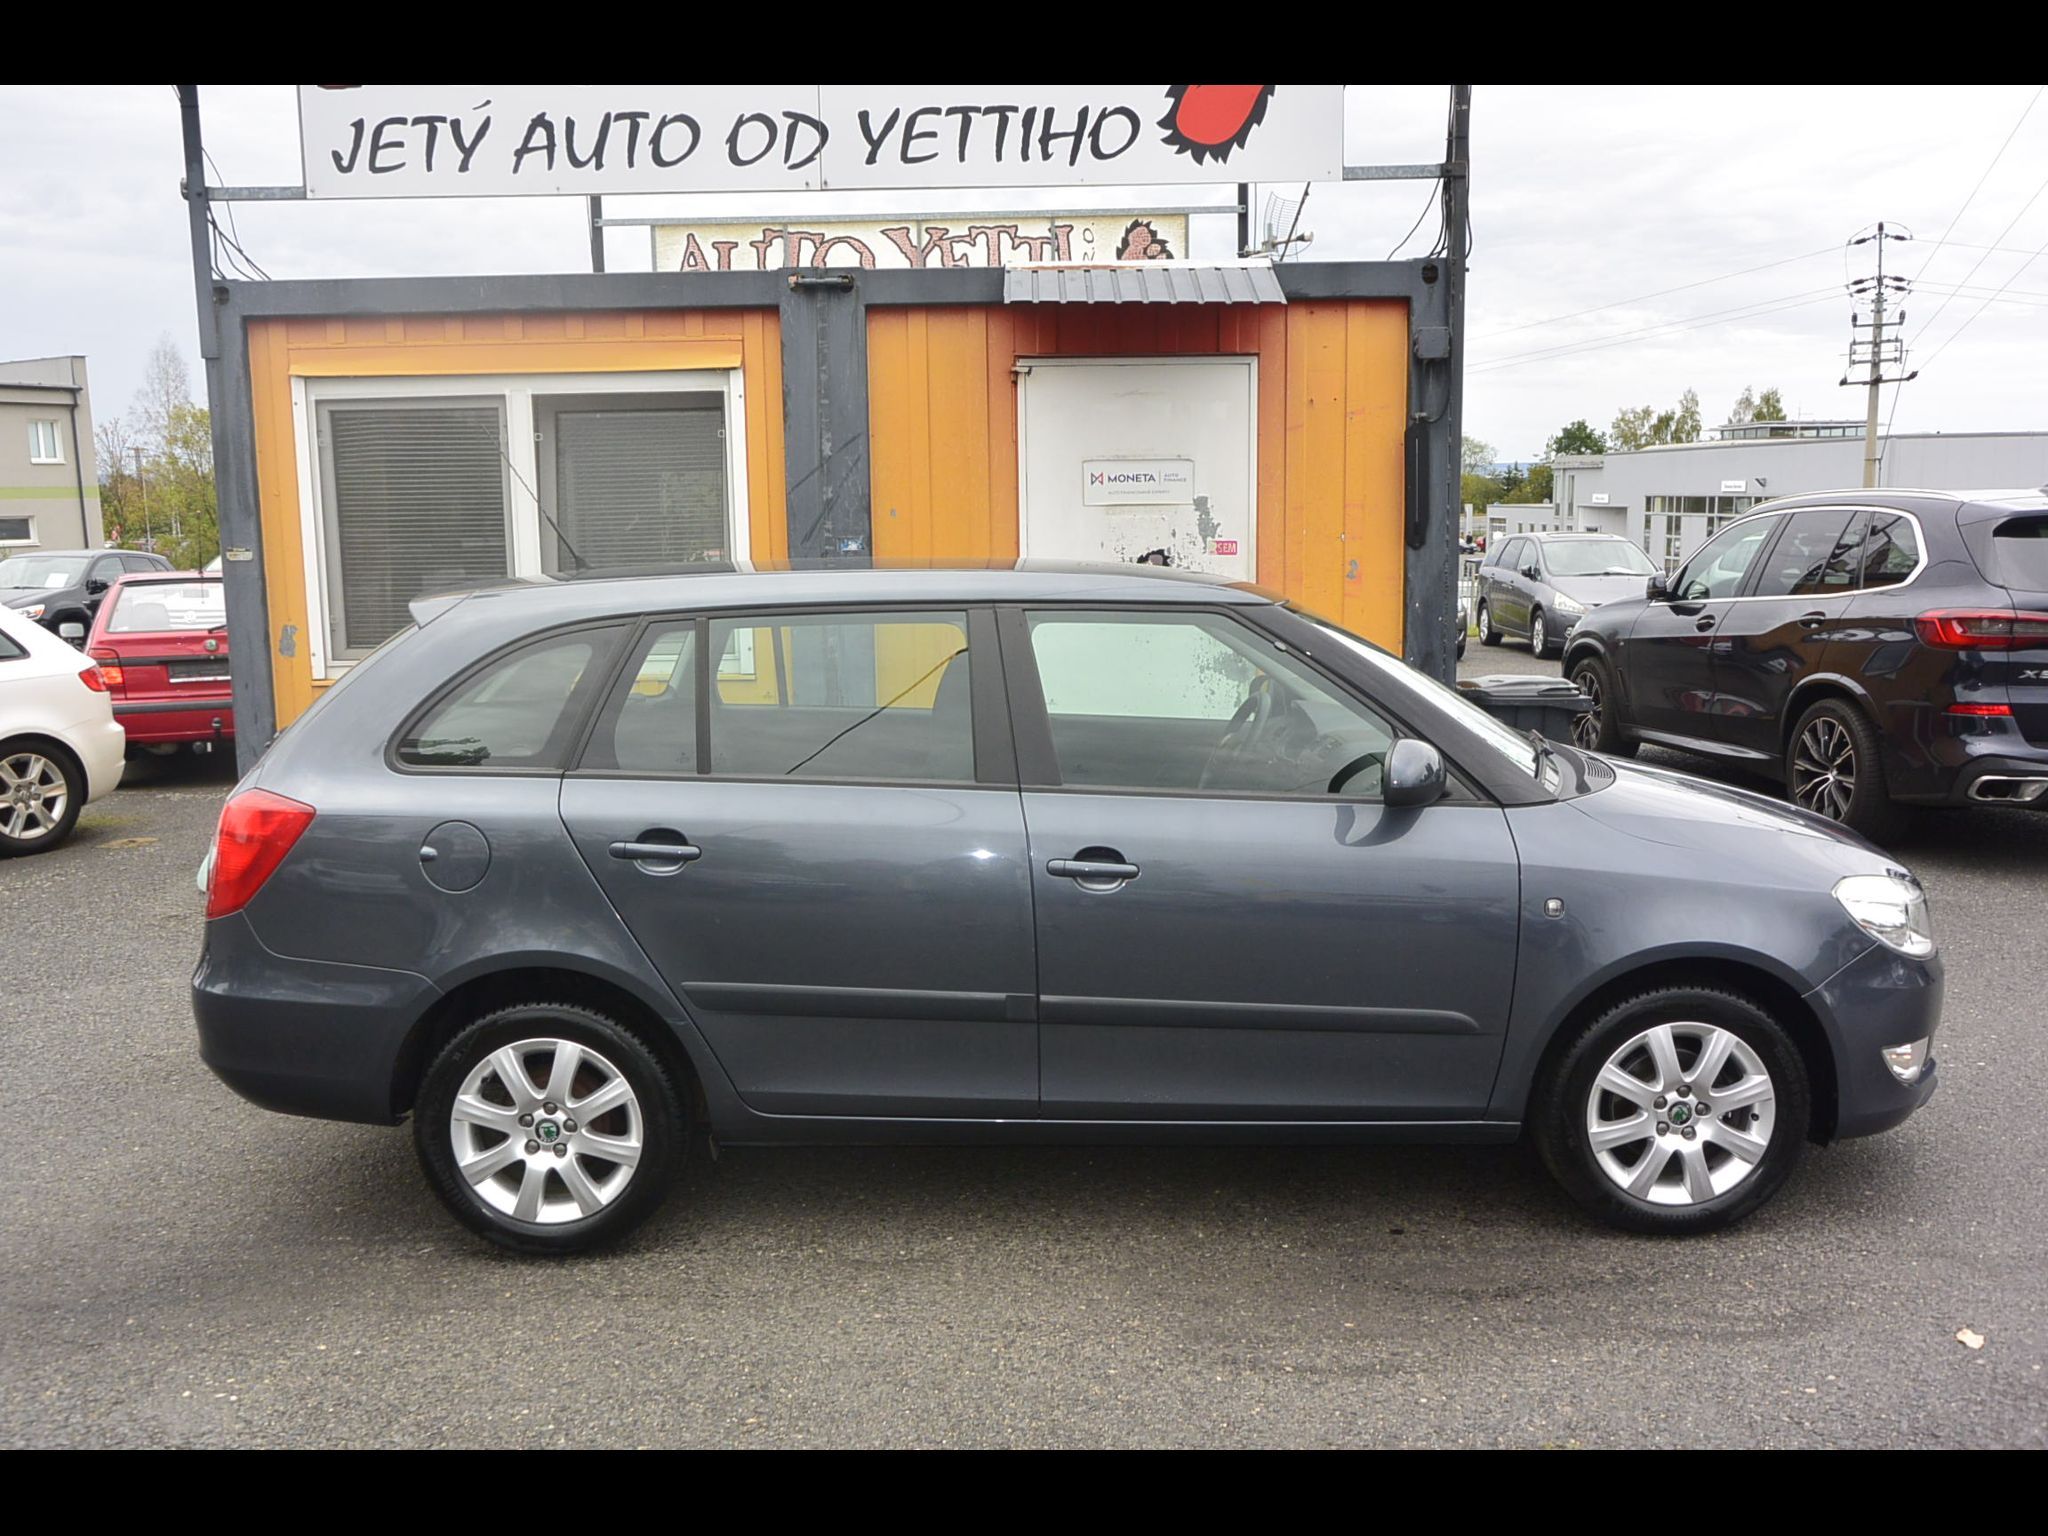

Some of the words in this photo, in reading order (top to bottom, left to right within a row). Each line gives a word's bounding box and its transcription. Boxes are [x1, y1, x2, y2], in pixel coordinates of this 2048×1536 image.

[331, 99, 492, 174] JETÝ
[512, 111, 701, 174] AUTO
[725, 111, 829, 170] OD
[857, 105, 1141, 167] YETTIHO
[1107, 473, 1156, 483] MONETA
